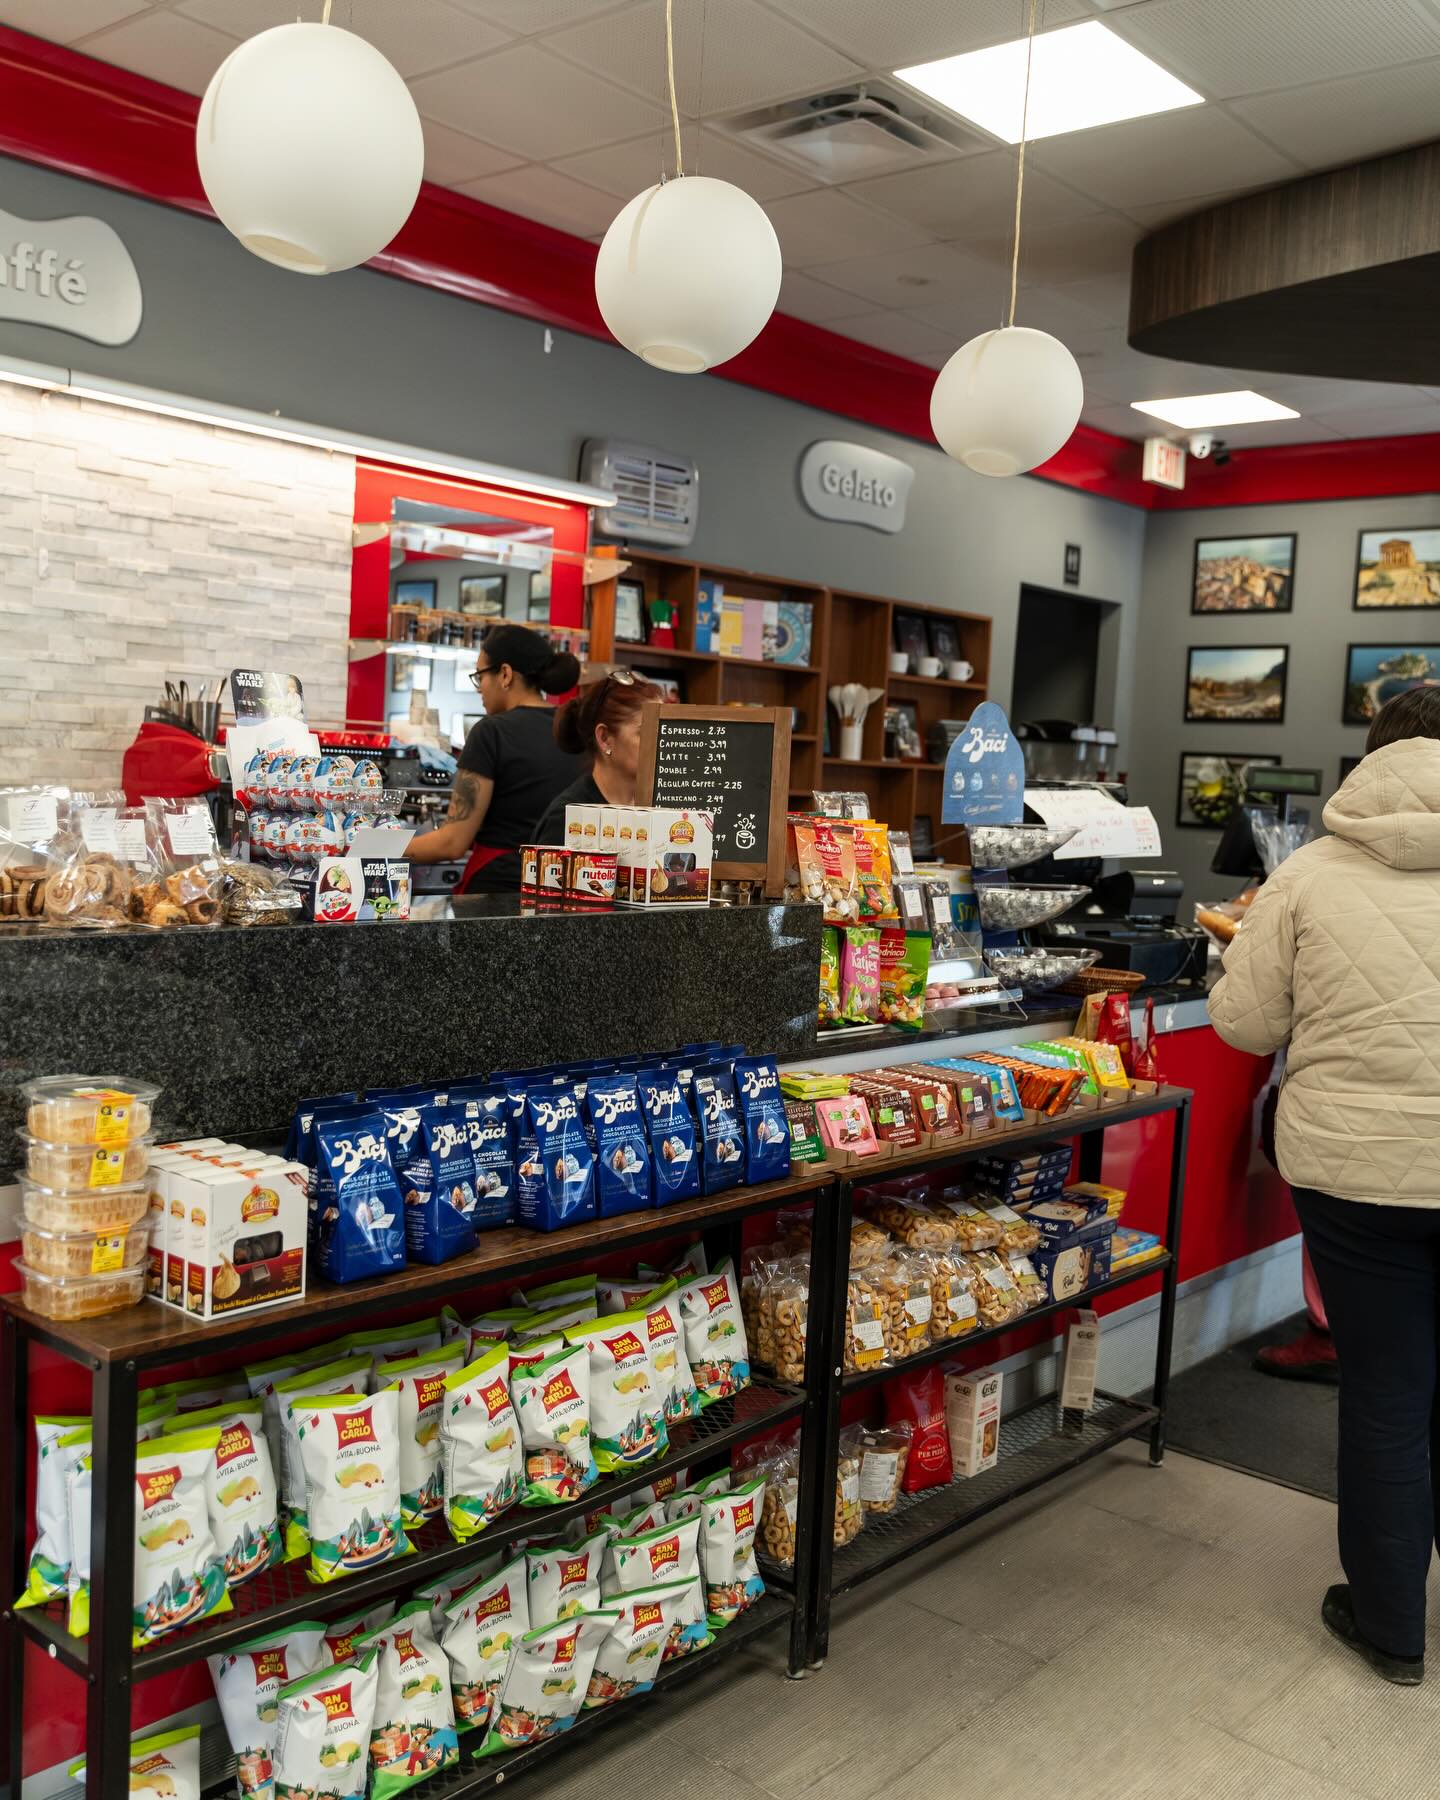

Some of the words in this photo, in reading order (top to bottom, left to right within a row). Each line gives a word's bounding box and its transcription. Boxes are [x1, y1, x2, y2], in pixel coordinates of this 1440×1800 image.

[821, 463, 896, 507] Gelato
[236, 679, 264, 688] WARS
[237, 672, 263, 681] STAR
[708, 726, 726, 735] 2.75
[709, 740, 727, 749] 3.99
[961, 727, 1009, 763] Baci
[659, 751, 689, 761] LATTE
[706, 753, 726, 761] 3.99
[658, 765, 688, 774] DOUBLE
[703, 766, 722, 775] 2.99
[657, 777, 690, 788] REGULAR
[723, 781, 742, 790] 2.25
[656, 792, 697, 802] AMERICANO
[706, 795, 724, 803] 2.49
[363, 869, 388, 877] WARS
[364, 863, 387, 871] STAR
[741, 1071, 778, 1098] Baci
[645, 1086, 682, 1116] Baci
[703, 1093, 735, 1121] Baci
[594, 1094, 638, 1125] Baci
[536, 1101, 578, 1133] Baci
[431, 1123, 469, 1159] Baci
[468, 1120, 508, 1151] Baci
[330, 1136, 387, 1173] Baci
[378, 1175, 392, 1183] LAIT
[708, 1285, 724, 1298] SAN
[709, 1291, 727, 1306] CARLO
[651, 1314, 667, 1327] SAN
[648, 1320, 672, 1336] CARLO
[612, 1337, 630, 1351] SAN
[613, 1341, 642, 1357] CARLO
[423, 1380, 442, 1393] SAN
[486, 1386, 502, 1400] SAN
[549, 1381, 564, 1393] AN
[487, 1392, 509, 1411] CARLO
[543, 1386, 573, 1405] CARLO
[345, 1416, 365, 1429] SAN
[222, 1430, 243, 1446] SAN
[340, 1425, 371, 1440] CARLO
[217, 1437, 250, 1459] CARLO
[340, 1449, 354, 1459] VITA
[355, 1444, 382, 1456] BUONA
[219, 1468, 235, 1479] VITA
[237, 1456, 259, 1471] BUONA
[149, 1474, 175, 1488] SAN
[737, 1508, 749, 1519] SAN
[735, 1515, 753, 1528] CARLO
[656, 1544, 673, 1554] SAN
[652, 1551, 678, 1565] CARLO
[567, 1562, 582, 1574] SAN
[477, 1600, 509, 1616] CARLO
[485, 1595, 504, 1608] SAN
[491, 1613, 513, 1627] BUONA
[635, 1610, 660, 1626] CARLO
[262, 1652, 281, 1664] SAN
[325, 1693, 342, 1704] AN
[334, 1718, 361, 1734] BUONA
